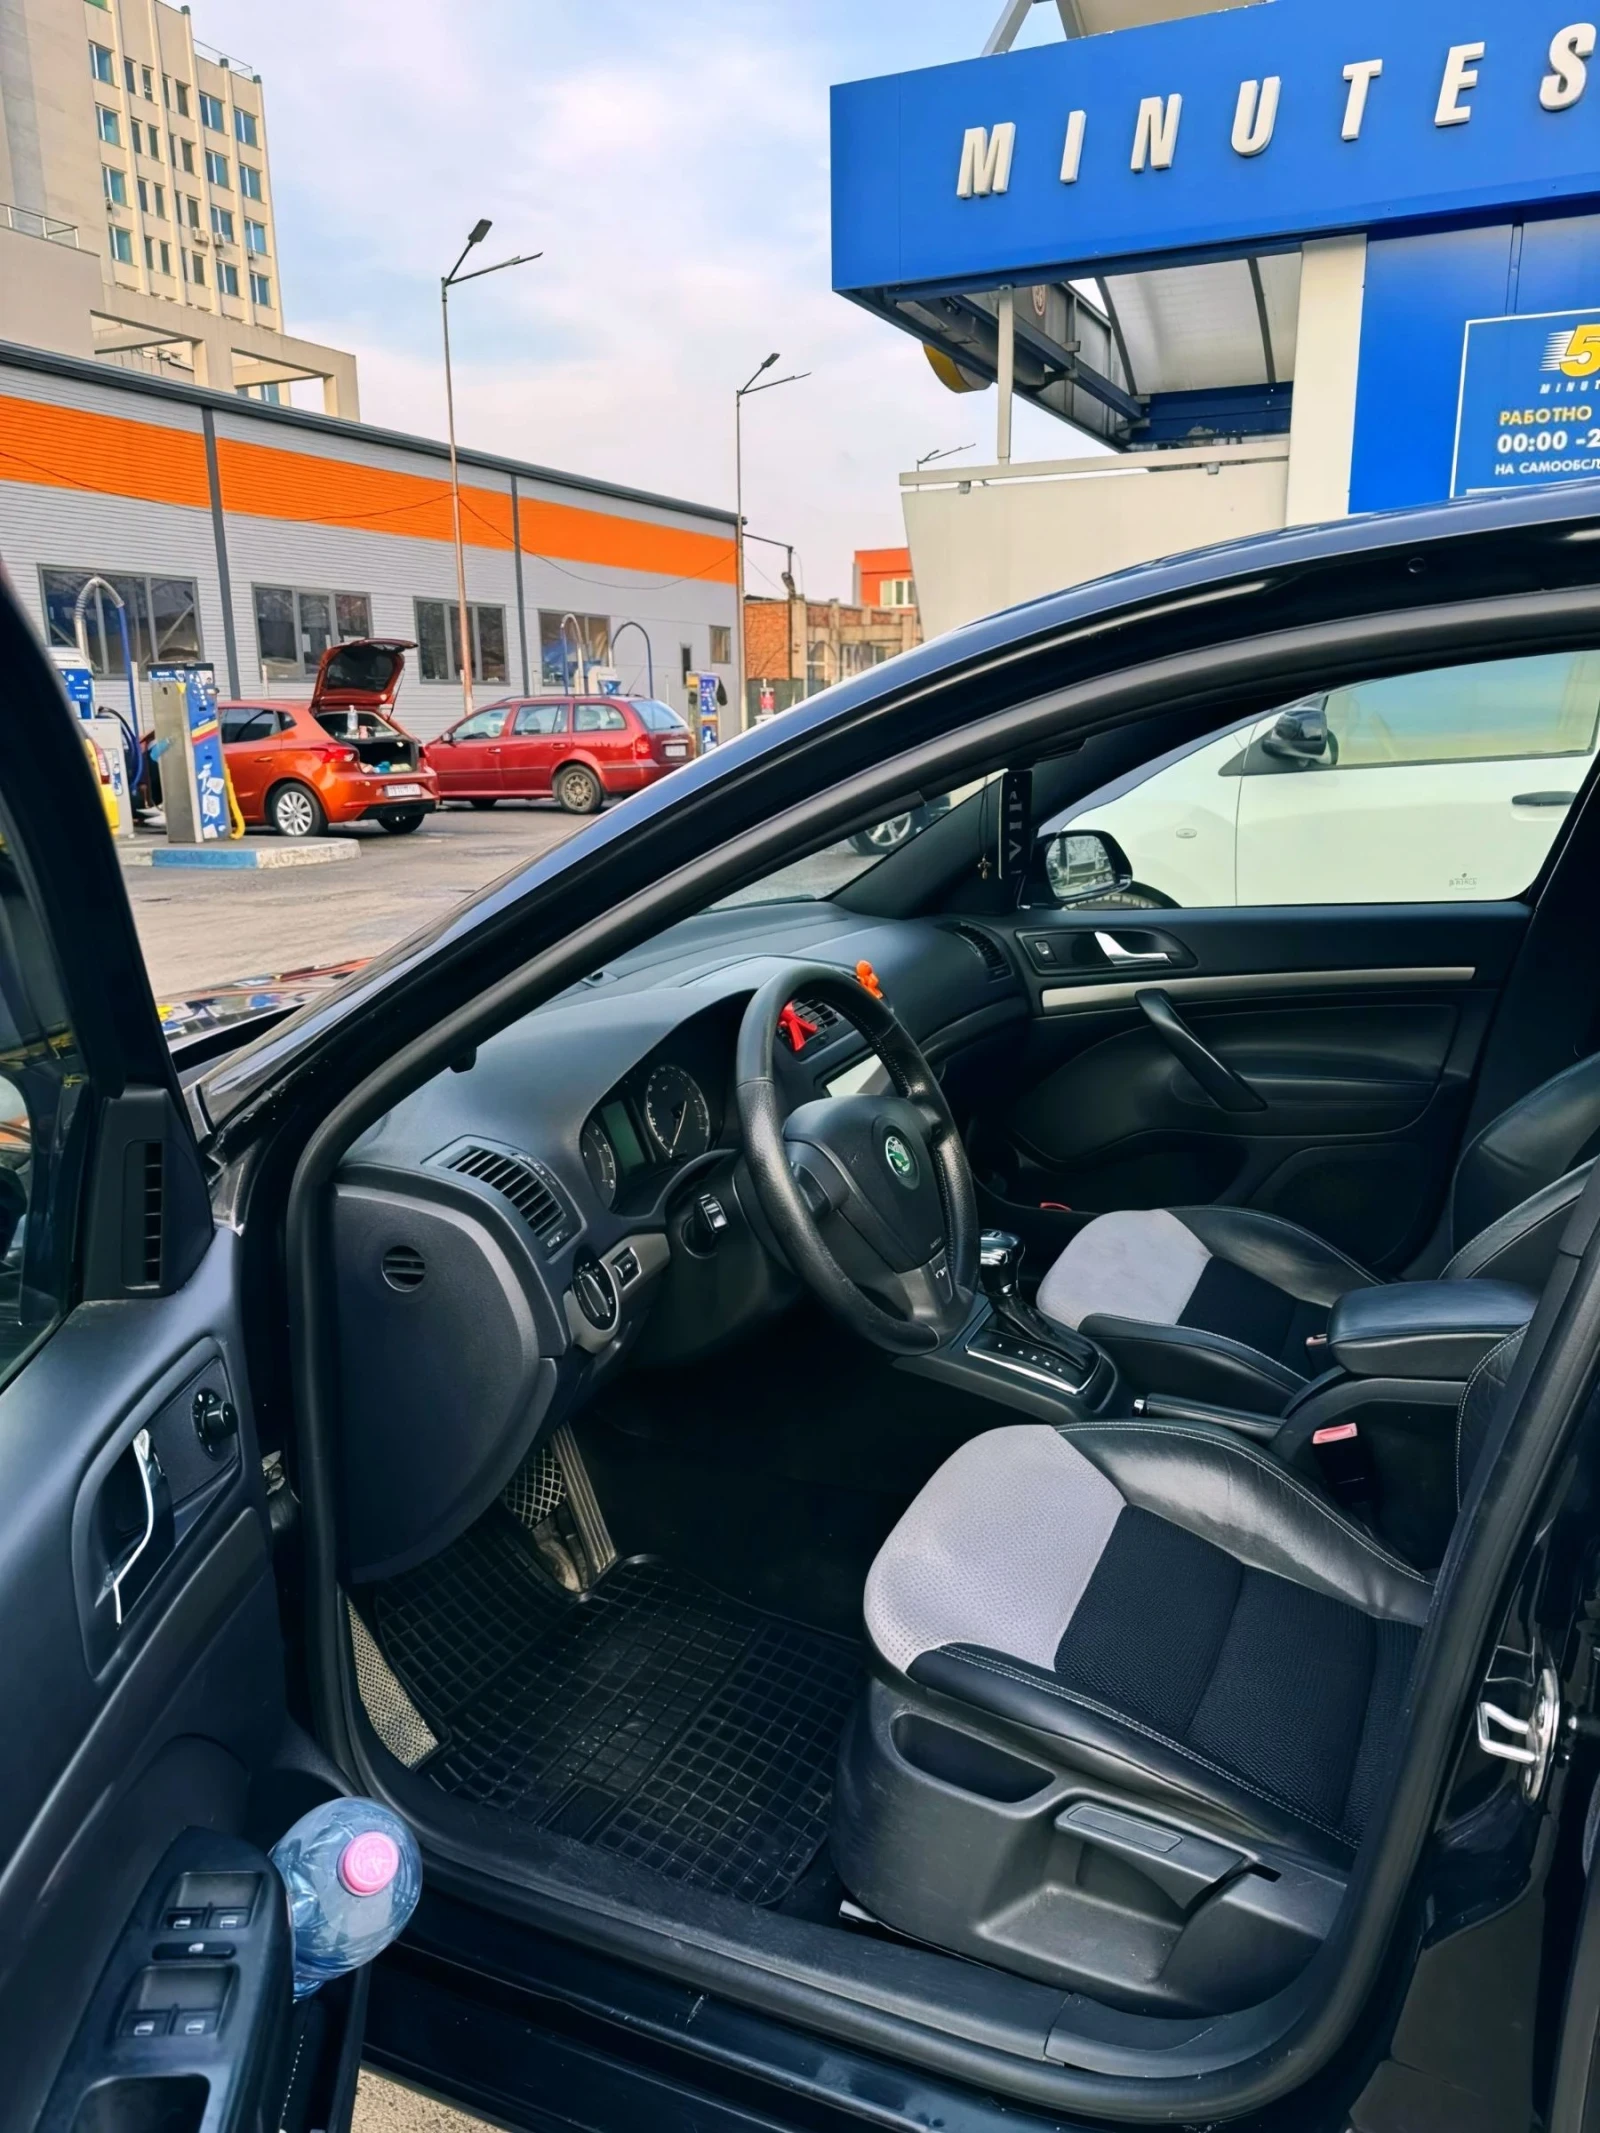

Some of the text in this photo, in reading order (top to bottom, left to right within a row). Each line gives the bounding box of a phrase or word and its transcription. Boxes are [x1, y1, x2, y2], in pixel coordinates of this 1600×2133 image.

[956, 22, 1597, 198] MINUTES
[1559, 324, 1600, 377] 5
[1499, 405, 1593, 426] РАБОТНО
[1497, 430, 1568, 454] 00:00
[1494, 463, 1515, 475] НА
